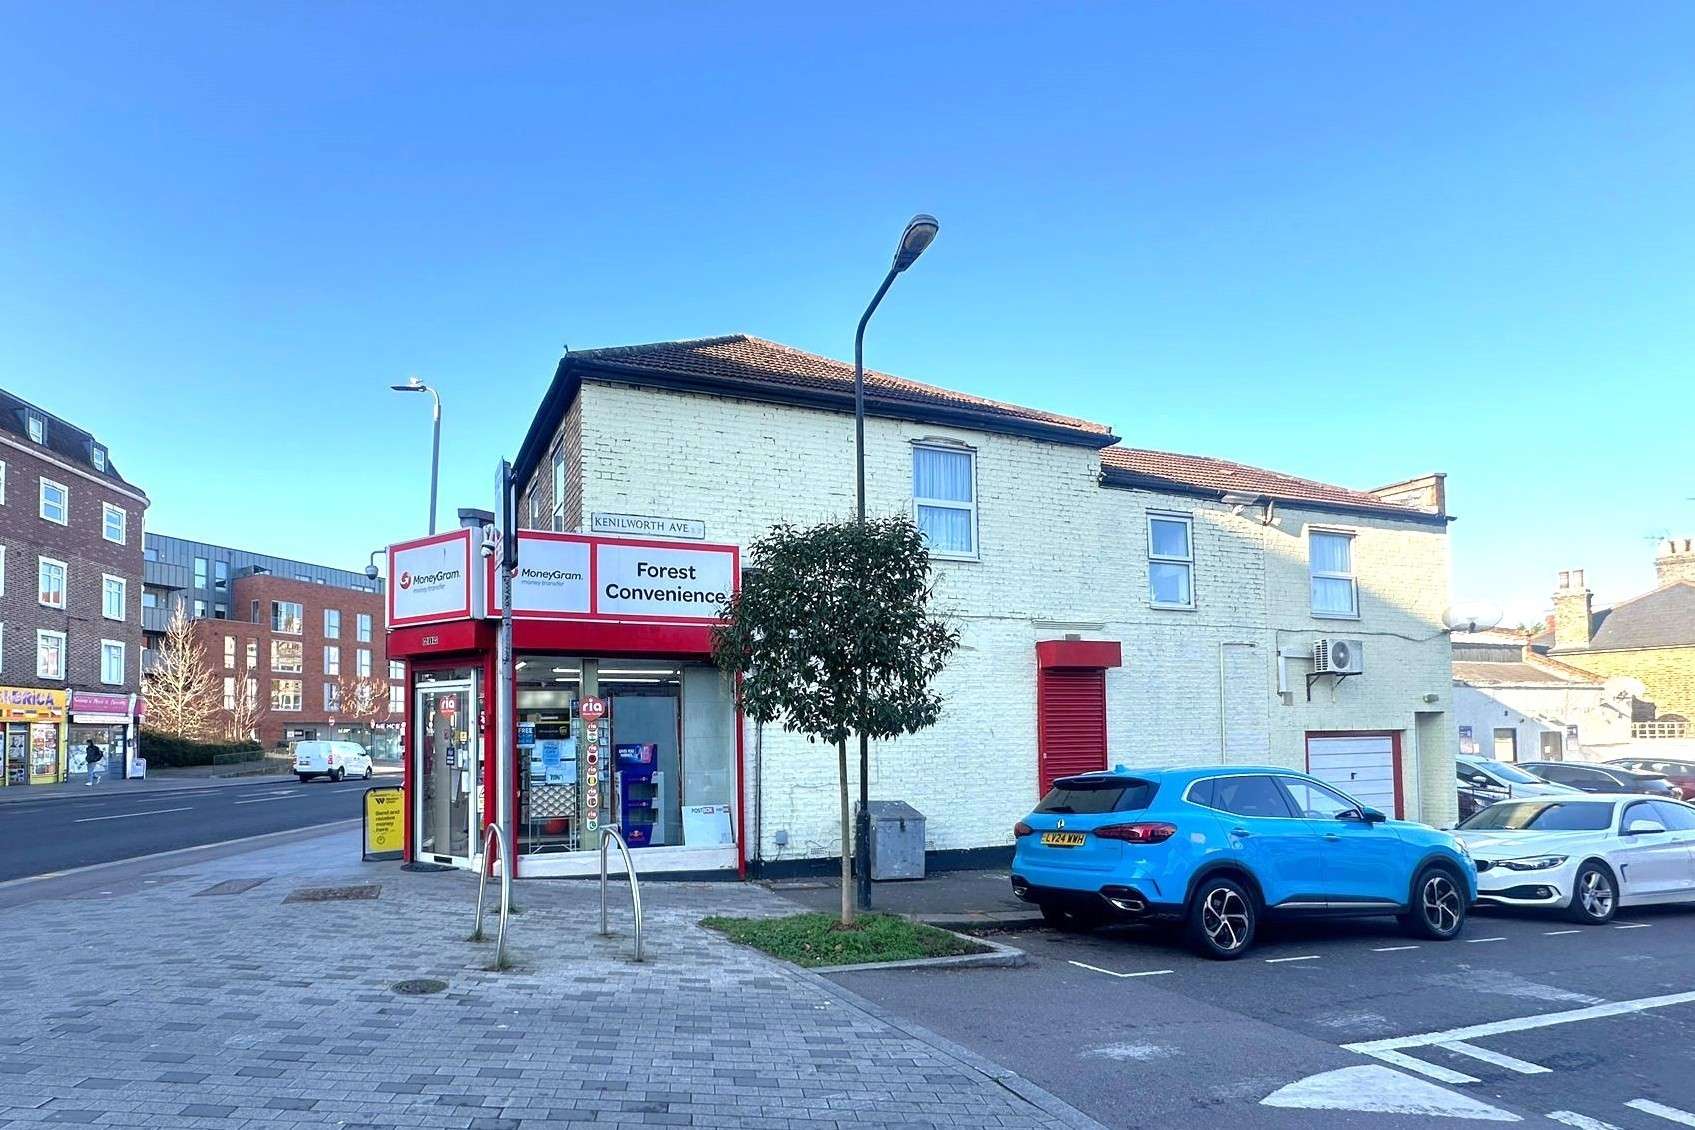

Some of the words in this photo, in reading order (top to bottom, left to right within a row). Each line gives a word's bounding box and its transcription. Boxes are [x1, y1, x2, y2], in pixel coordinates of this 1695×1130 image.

[595, 517, 664, 531] KENILWORTH
[669, 523, 688, 532] AVE
[413, 570, 459, 585] MoneyGram
[521, 568, 581, 580] MoneyGram
[637, 562, 696, 580] Forest
[605, 583, 726, 604] Convenience
[441, 696, 455, 710] ria
[582, 698, 603, 712] ria
